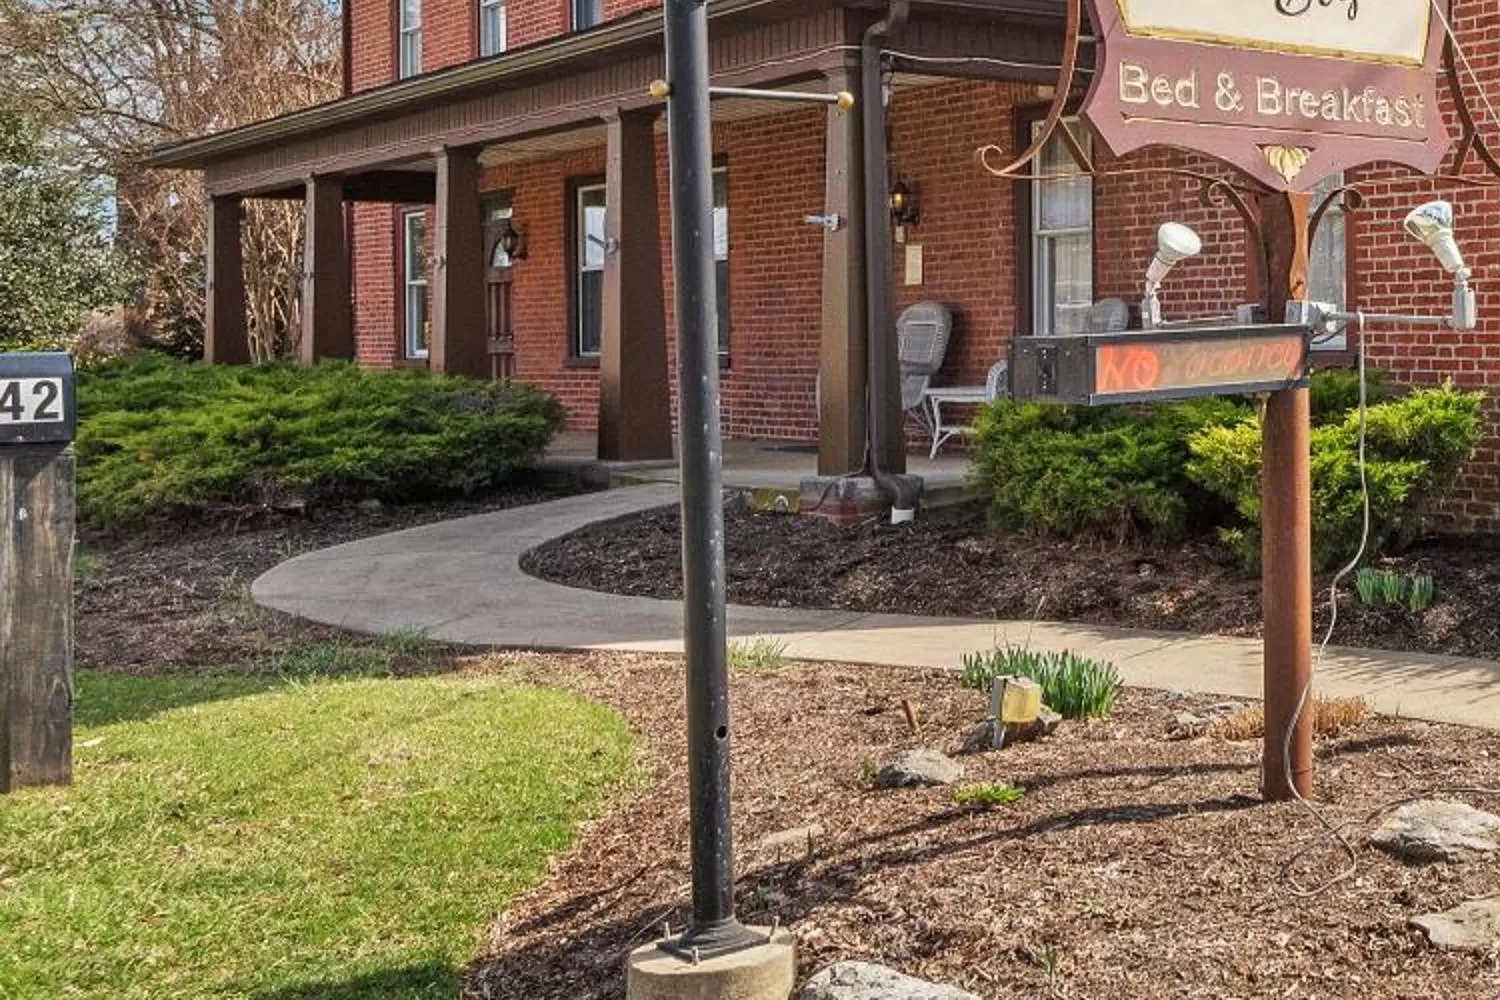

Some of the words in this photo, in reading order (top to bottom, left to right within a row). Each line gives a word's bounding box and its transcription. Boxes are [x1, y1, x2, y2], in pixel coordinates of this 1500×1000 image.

[1118, 60, 1200, 109] Bed
[1215, 71, 1244, 114] &
[1256, 76, 1426, 130] Breakfast
[0, 379, 59, 421] 42
